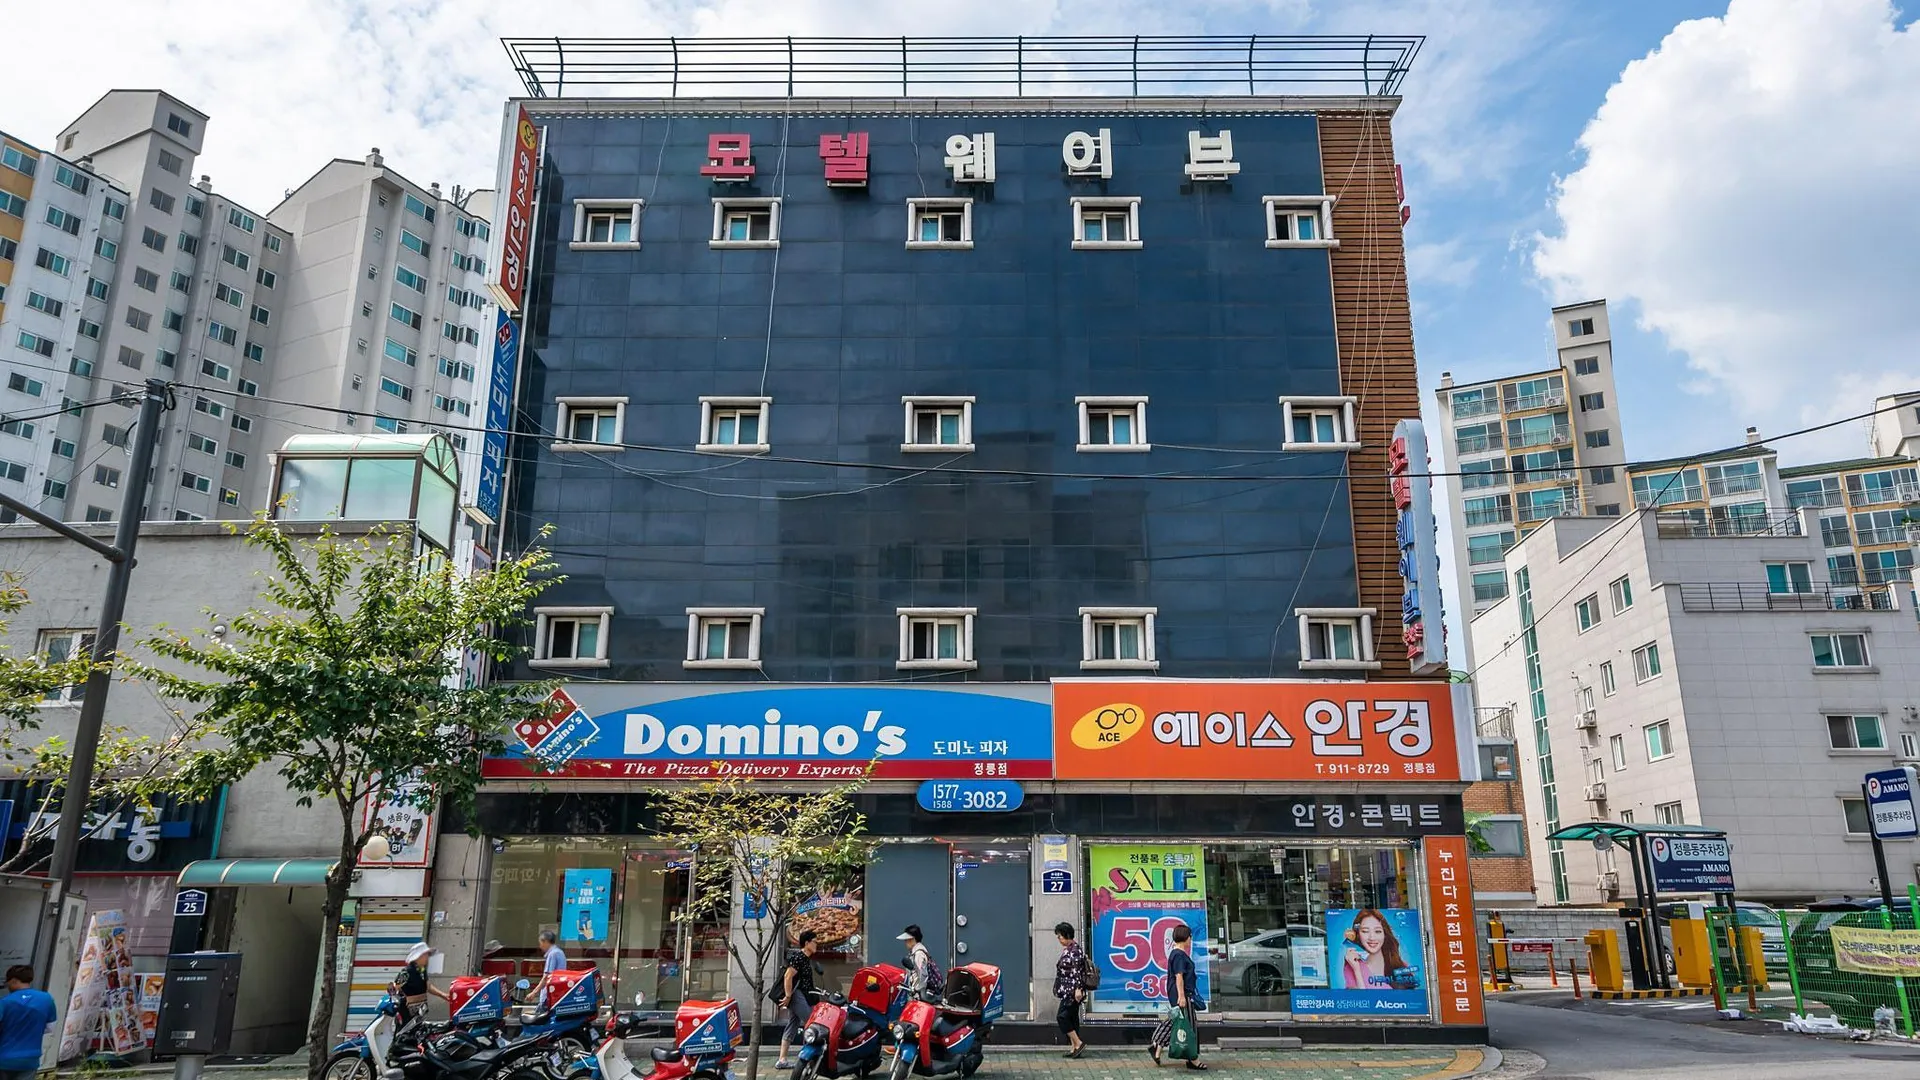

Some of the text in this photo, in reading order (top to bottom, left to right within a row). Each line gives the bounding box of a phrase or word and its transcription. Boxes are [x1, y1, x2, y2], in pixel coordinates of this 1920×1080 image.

[624, 709, 907, 755] Domino's
[1152, 699, 1433, 757] 에이스 안경
[1098, 733, 1120, 742] ACE
[933, 740, 1008, 756] 도미노 피자
[623, 762, 863, 777] The Pizza Delivery Experts
[974, 762, 1007, 776] 정릉점
[1329, 764, 1390, 775] 911-8729
[1403, 762, 1435, 775] 정릉점
[933, 784, 960, 799] 1577
[1883, 783, 1909, 794] AMANO
[933, 801, 952, 809] 1588
[1674, 843, 1725, 856] 정릉동주차장
[1129, 853, 1195, 866] 전품목 초특가
[1702, 864, 1730, 872] AMANO
[1050, 881, 1064, 892] 27
[1106, 867, 1198, 893] SALE
[183, 902, 197, 912] 25
[1439, 850, 1470, 1012] 누진다초점렌즈전문
[1375, 1000, 1407, 1009] Alcon
